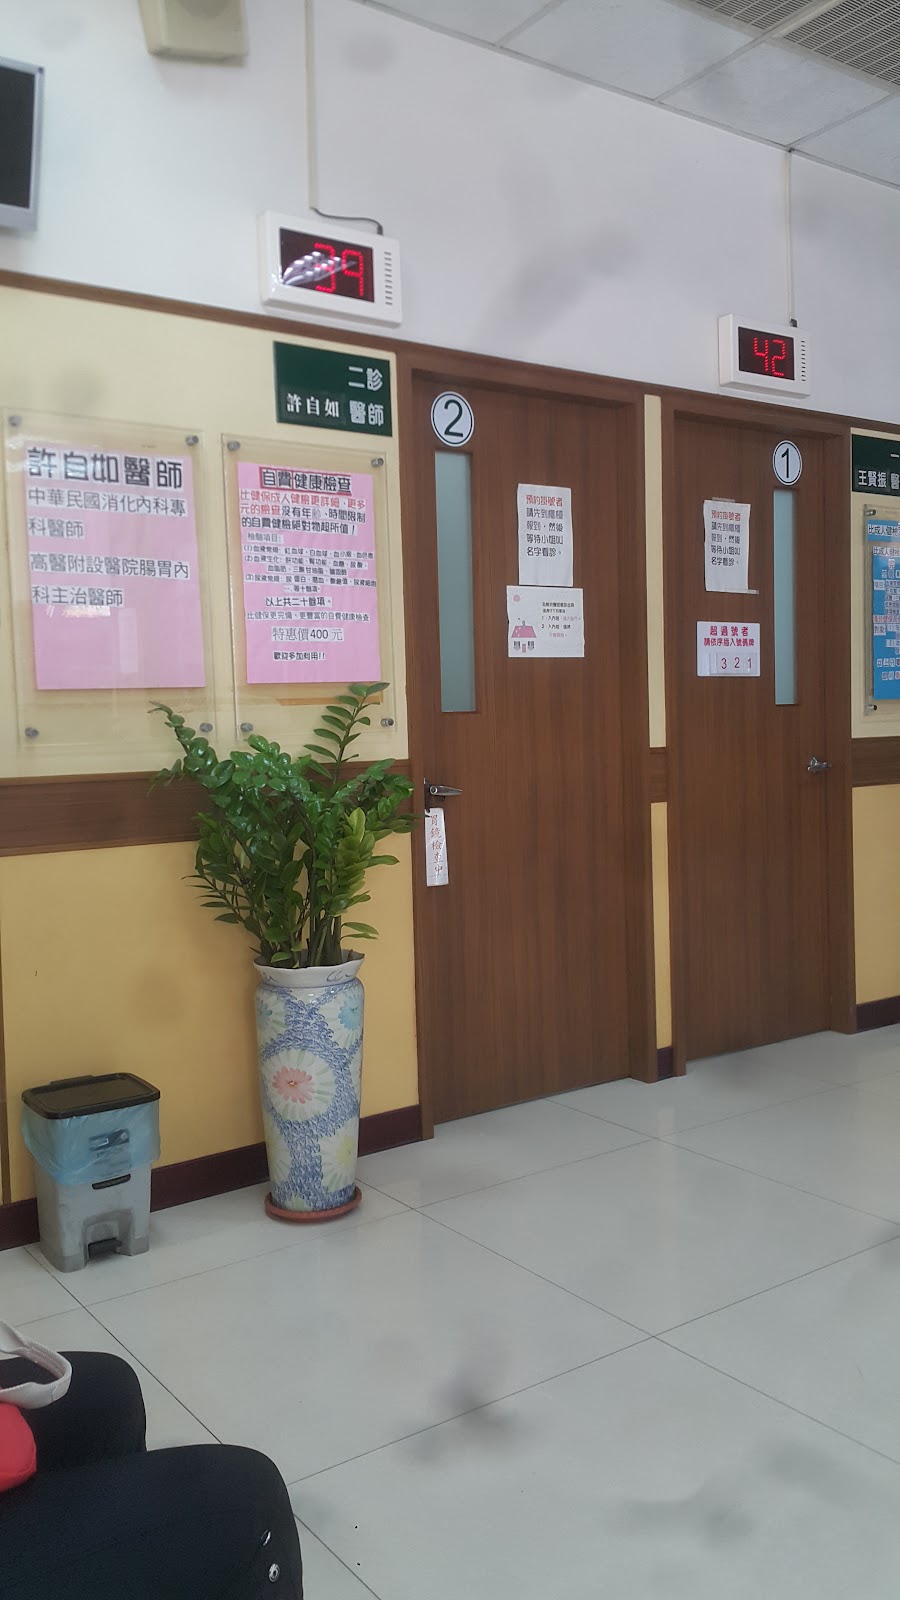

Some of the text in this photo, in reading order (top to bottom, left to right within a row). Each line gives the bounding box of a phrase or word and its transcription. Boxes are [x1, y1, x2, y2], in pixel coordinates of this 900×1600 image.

[314, 242, 364, 297] 39
[753, 337, 786, 377] 42
[348, 366, 383, 391] 二診
[286, 393, 384, 427] 許自如 醫師
[443, 399, 464, 438] 2
[28, 446, 183, 490] 許自如醫師
[781, 447, 790, 479] 1
[262, 469, 352, 494] 自費健康檢查
[858, 470, 887, 488] 王賢振
[28, 488, 187, 517] 中華民國消化內科專
[28, 518, 84, 539] 科醫師
[30, 553, 189, 579] 高醫附設醫院腸胃內
[32, 585, 124, 607] 科主治醫師
